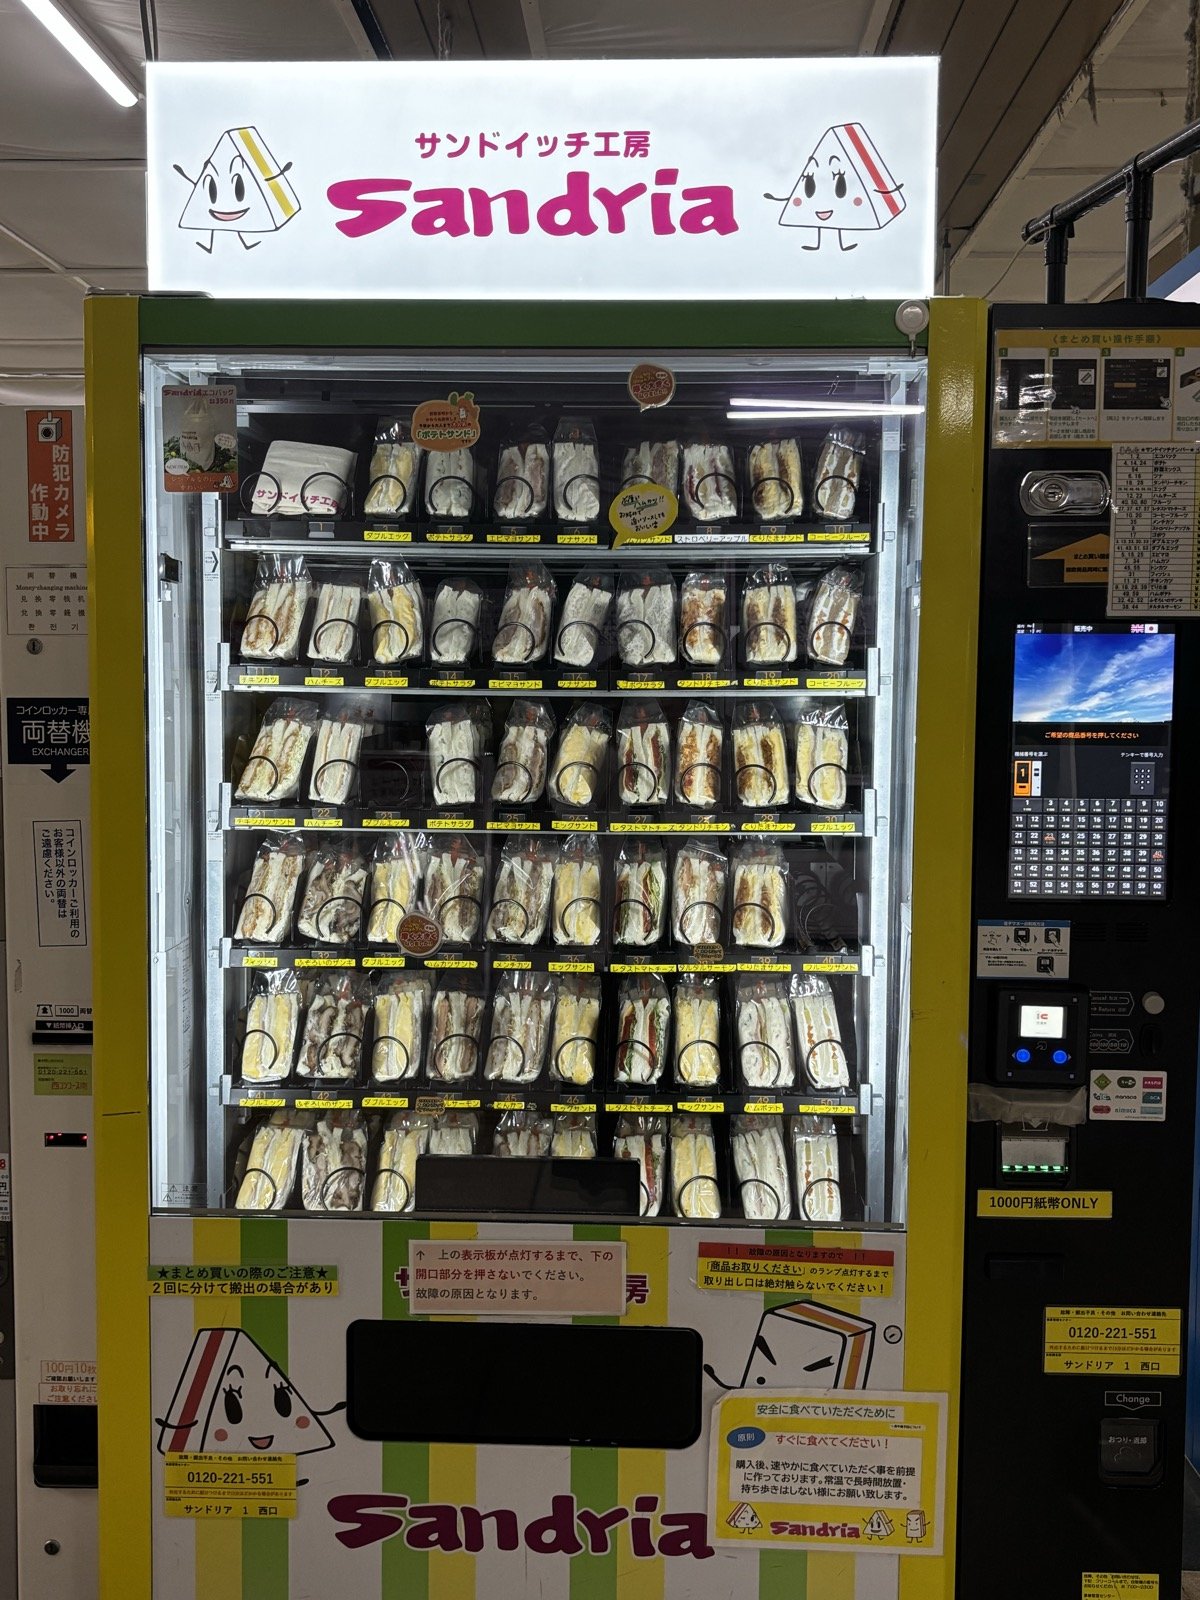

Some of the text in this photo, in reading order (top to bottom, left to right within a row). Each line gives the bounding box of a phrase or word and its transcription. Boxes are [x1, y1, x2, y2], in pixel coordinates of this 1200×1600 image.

[414, 130, 651, 158] サンドイッチ工房
[326, 168, 739, 238] Sandria
[52, 444, 70, 540] 防犯カメラ
[30, 483, 49, 540] 作動中
[366, 532, 409, 540] ダブルエッグ
[559, 535, 596, 543] ツナサンド
[676, 535, 748, 543] ストロベリーアップル
[1074, 625, 1093, 633] 販売中
[306, 678, 342, 686] ハムチーズ
[366, 678, 407, 686] ダブルエッグ
[16, 705, 89, 716] コインロッカー専
[21, 719, 90, 745] 両替機
[1044, 731, 1140, 739] ご希望の商品番号を押してください
[32, 747, 89, 756] EXCHANGER
[429, 820, 472, 828] ポテトサラダ
[553, 822, 596, 830] エッグサンド
[812, 823, 854, 831] ダブルエッグ
[41, 829, 55, 903] ご遠慮ください。
[53, 828, 67, 919] お客様以外の両替は
[65, 828, 80, 939] コインロッカーご利用の
[363, 958, 404, 966] ダブルエッグ
[551, 963, 593, 971] エッグサンド
[680, 1103, 723, 1111] エッグサンド
[745, 1104, 781, 1112] ハムポテト
[989, 1196, 1099, 1211] 1000円紙幣ONLY
[438, 1249, 613, 1262] 上の表示板が点灯するまで、下の
[415, 1268, 585, 1282] 開口部分を押さないでください。
[703, 1275, 885, 1294] 取り出し口は絶対触らないでください！
[415, 1287, 538, 1301] 故障の原因となります。
[1068, 1326, 1157, 1340] 0120-221-551
[1064, 1360, 1160, 1371] サンドリア 1 西口
[1115, 1393, 1151, 1405] Change
[757, 1404, 896, 1419] 安全に食べていただくために
[737, 1433, 755, 1442] 原則
[775, 1434, 889, 1449] すぐに食べてください！
[735, 1459, 917, 1477] 購入後、速やかに食べていただく事を前提
[187, 1471, 273, 1485] 0120-221-551
[740, 1484, 908, 1501] 持ち歩きはしない様にお願い致します。
[184, 1505, 278, 1516] サンドリア 1 西口
[326, 1494, 716, 1560] Sandria
[770, 1521, 861, 1539] Sandria
